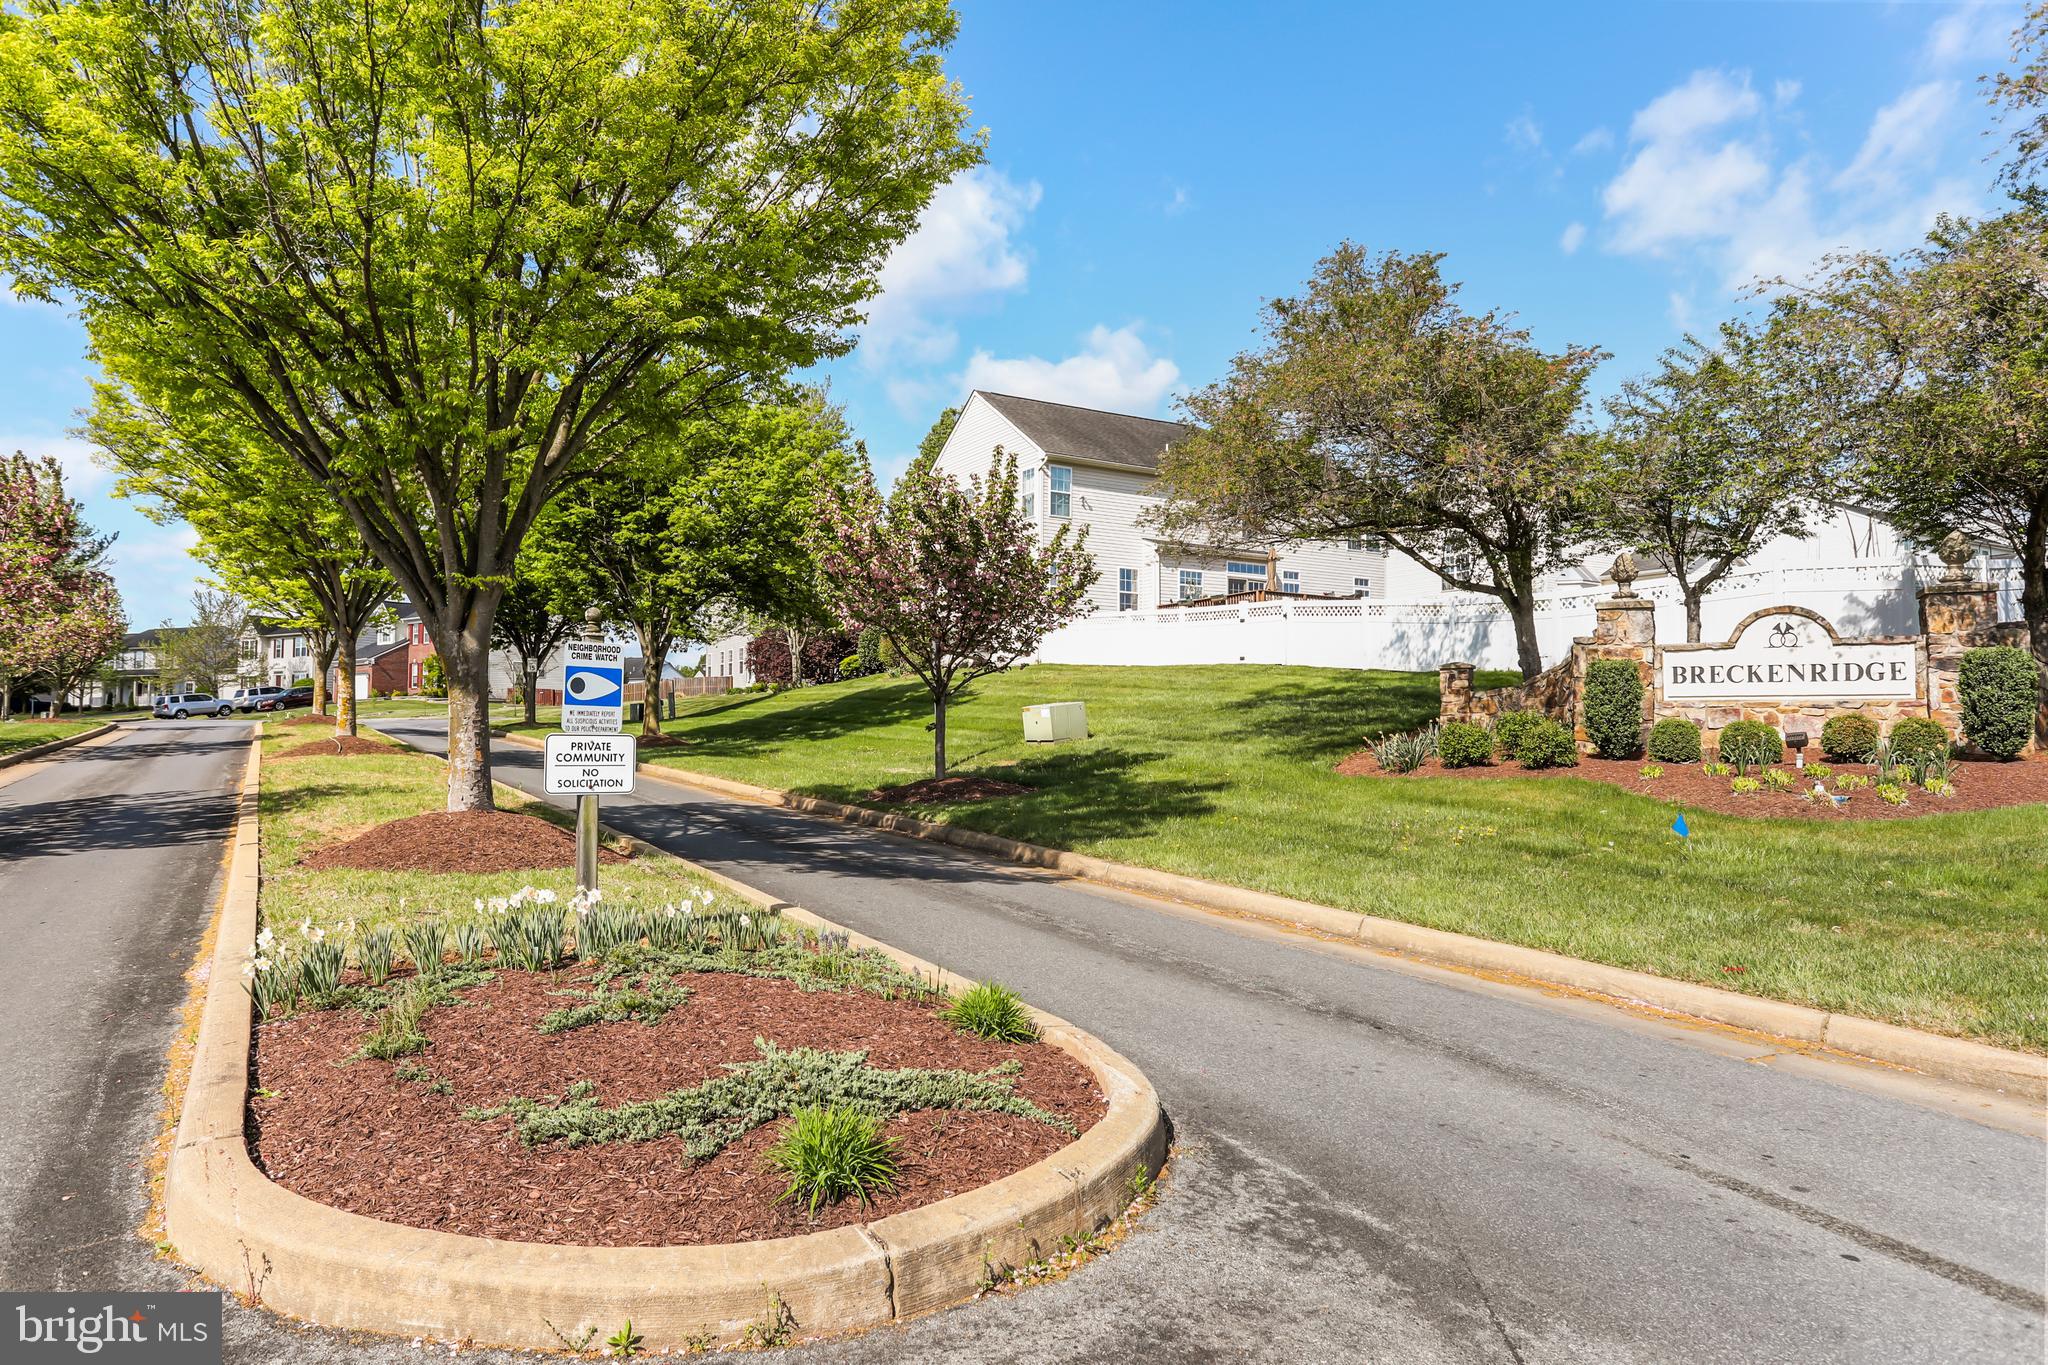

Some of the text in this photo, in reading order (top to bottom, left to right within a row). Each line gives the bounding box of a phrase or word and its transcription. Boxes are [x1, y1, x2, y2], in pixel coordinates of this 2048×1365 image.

[568, 643, 621, 654] NEIGHBORHOOD
[571, 652, 592, 660] CRIME
[1672, 661, 1907, 685] BRECKENRIDGE
[571, 742, 611, 751] PRIVATE
[556, 753, 625, 762] COMMUNITY
[582, 769, 599, 777] NO
[557, 779, 623, 788] SOLICITATION
